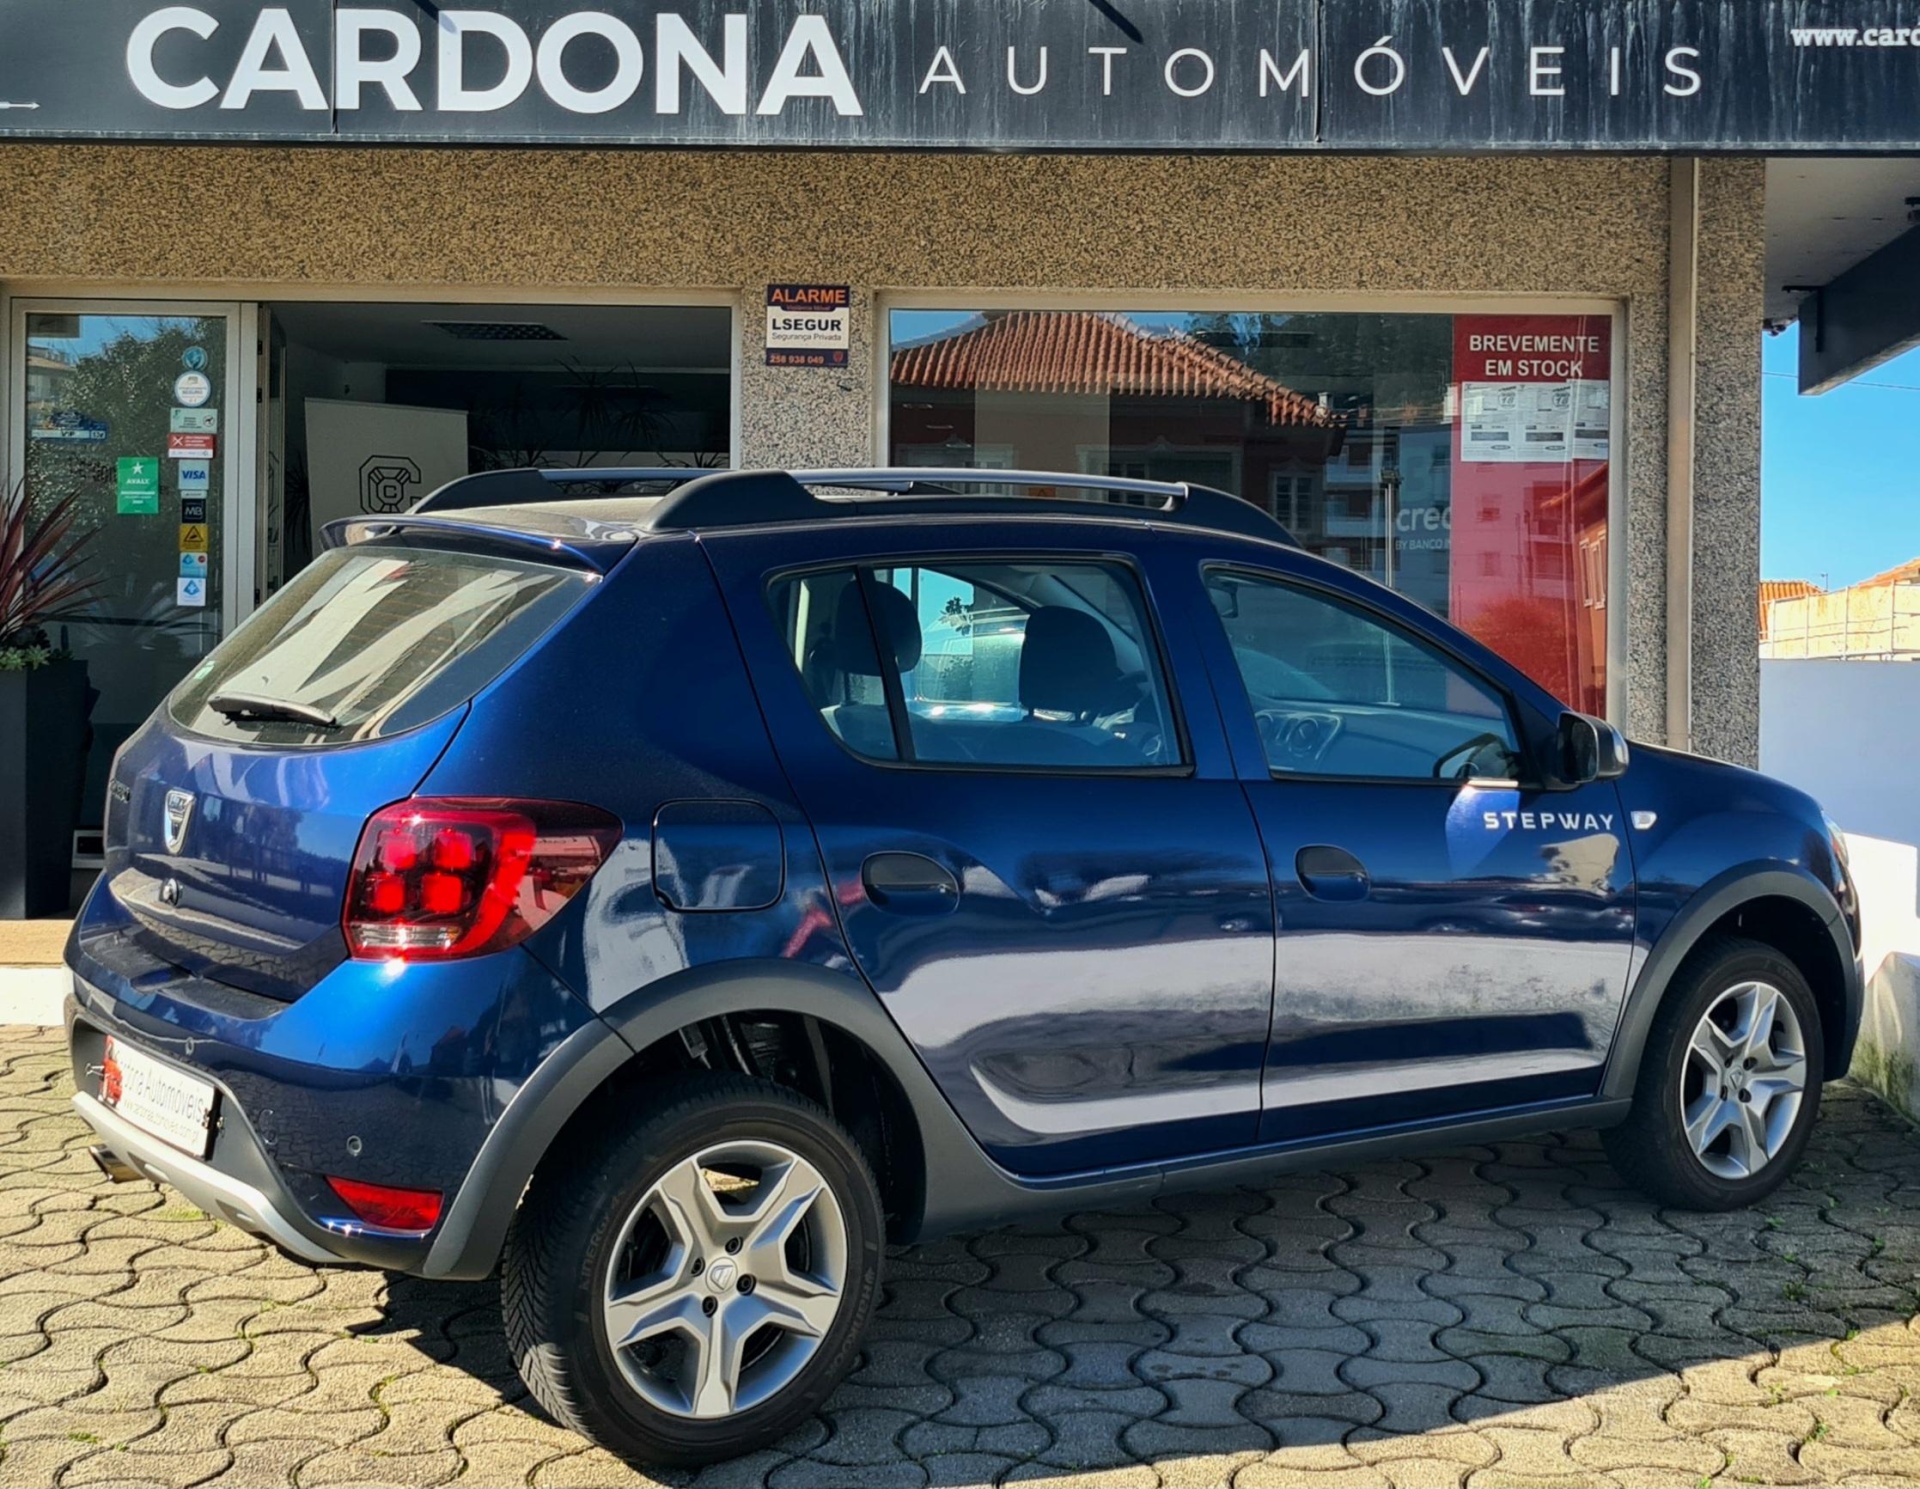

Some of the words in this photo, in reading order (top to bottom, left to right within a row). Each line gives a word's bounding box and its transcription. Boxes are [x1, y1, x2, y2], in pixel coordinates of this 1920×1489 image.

[126, 6, 864, 117] CARDONA
[919, 36, 1702, 98] AUTOMÓVEIS
[771, 288, 846, 304] ALARME
[772, 318, 841, 331] LSEGUR
[772, 332, 812, 342] Segurança
[814, 333, 842, 341] Privada
[1469, 335, 1600, 352] BREVEMENTE
[1485, 360, 1512, 376] EM
[1517, 360, 1583, 377] STOCK
[182, 470, 206, 479] VISA
[1409, 538, 1443, 550] BANCO
[1483, 812, 1613, 830] STEPWAY
